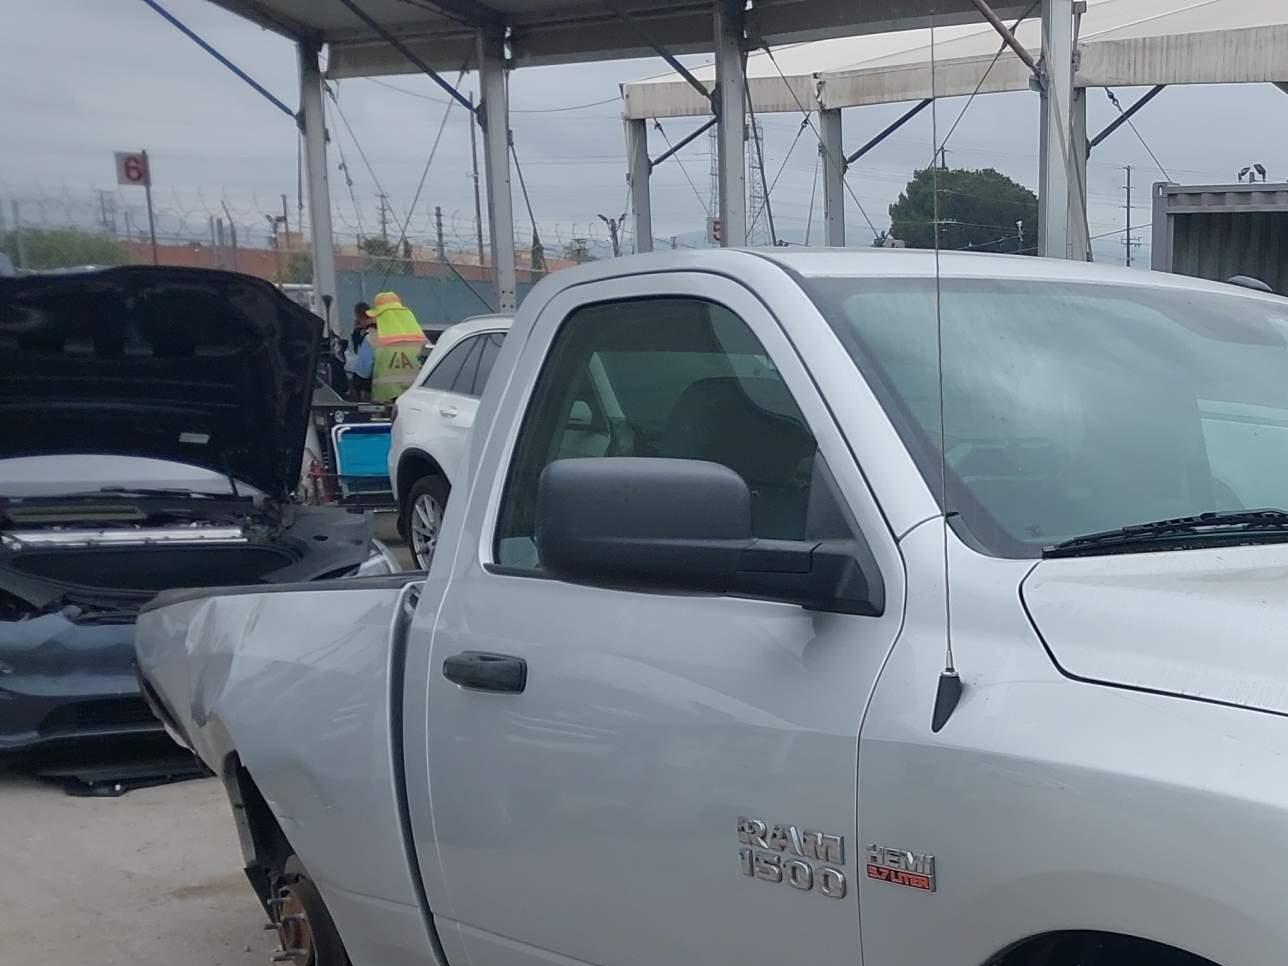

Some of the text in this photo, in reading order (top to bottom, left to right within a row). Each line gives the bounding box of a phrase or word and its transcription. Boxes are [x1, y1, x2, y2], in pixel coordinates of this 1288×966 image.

[124, 156, 144, 182] 6
[737, 816, 846, 866] RAM
[738, 848, 847, 899] 1500
[865, 843, 936, 878] HEMI
[867, 864, 931, 890] 5.7 LITER
